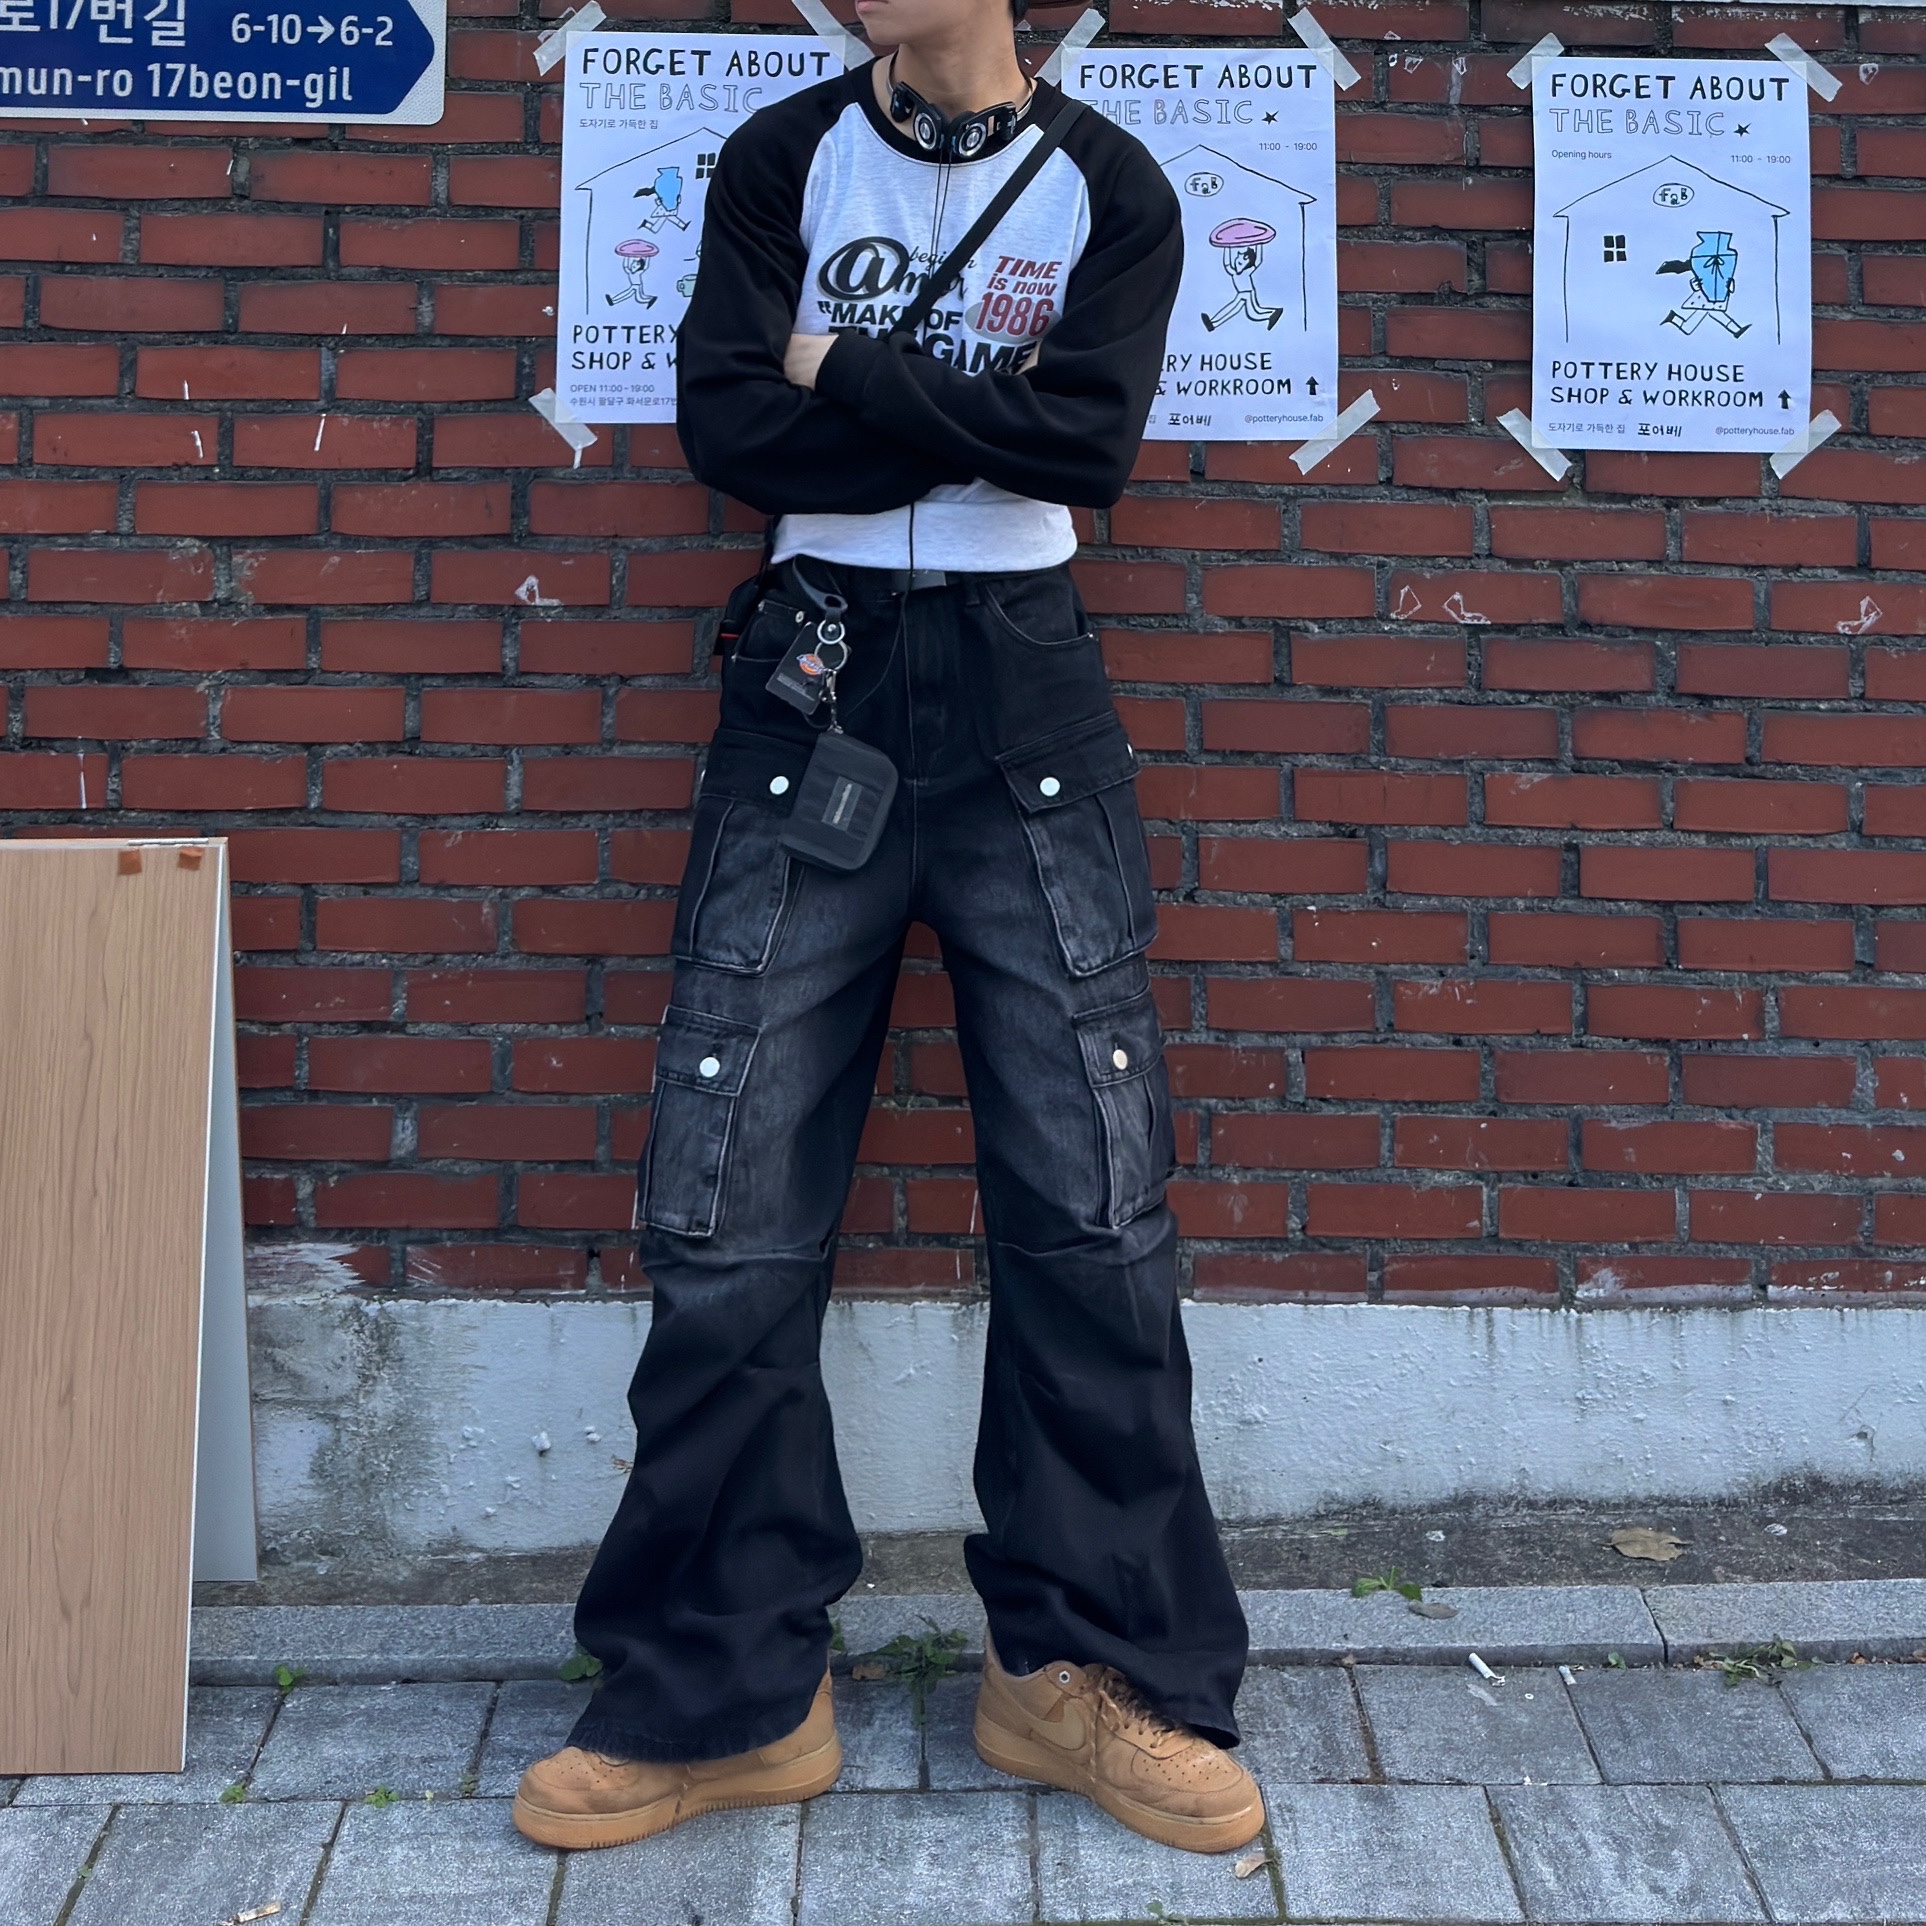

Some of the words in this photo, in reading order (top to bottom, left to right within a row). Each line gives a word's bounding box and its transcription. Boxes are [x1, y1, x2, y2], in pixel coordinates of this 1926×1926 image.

[231, 13, 301, 44] 6-10
[340, 16, 394, 46] 6-2
[582, 47, 712, 76] FORGET
[725, 50, 830, 77] ABOUT
[147, 63, 353, 108] 17beon-gil
[1080, 63, 1204, 89] FORGET
[1217, 64, 1317, 89] ABOUT
[1551, 73, 1676, 100] FORGET
[1689, 76, 1790, 101] ABOUT
[579, 82, 646, 110] THE
[660, 83, 762, 114] BASIC
[1153, 98, 1253, 125] BASIC
[1549, 108, 1613, 134] THE
[1625, 109, 1725, 136] BASIC
[579, 118, 617, 129] 도자기로
[618, 118, 647, 130] 가득한
[649, 119, 659, 130] 집
[1258, 142, 1281, 151] 11:00
[1294, 142, 1318, 151] 19:00
[1551, 149, 1587, 161] Opening
[1588, 150, 1612, 160] hours
[1731, 155, 1754, 164] 11:00
[1766, 155, 1791, 164] 19:00
[995, 255, 1062, 279] TIME
[986, 273, 1008, 290] is
[1012, 281, 1057, 296] now
[926, 309, 963, 331] OF
[976, 292, 1054, 336] 1986
[573, 325, 678, 344] POTTERY
[571, 351, 632, 370] SHOP
[641, 352, 656, 370] &
[1199, 352, 1273, 372] HOUSE
[1551, 360, 1658, 381] POTTERY
[1667, 363, 1745, 383] HOUSE
[570, 384, 597, 393] OPEN
[599, 384, 623, 393] 11:00
[630, 384, 655, 393] 19:00
[1176, 378, 1292, 397] WORKROOM
[1550, 386, 1610, 405] SHOP
[1618, 388, 1633, 405] &
[1643, 389, 1764, 408] WORKROOM
[1244, 413, 1324, 425] @potteryhouse.fab
[1548, 422, 1584, 433] 도자기로
[1586, 423, 1614, 435] 가득한
[1616, 424, 1626, 435] 집
[1715, 425, 1795, 437] @potteryhouse.fab
